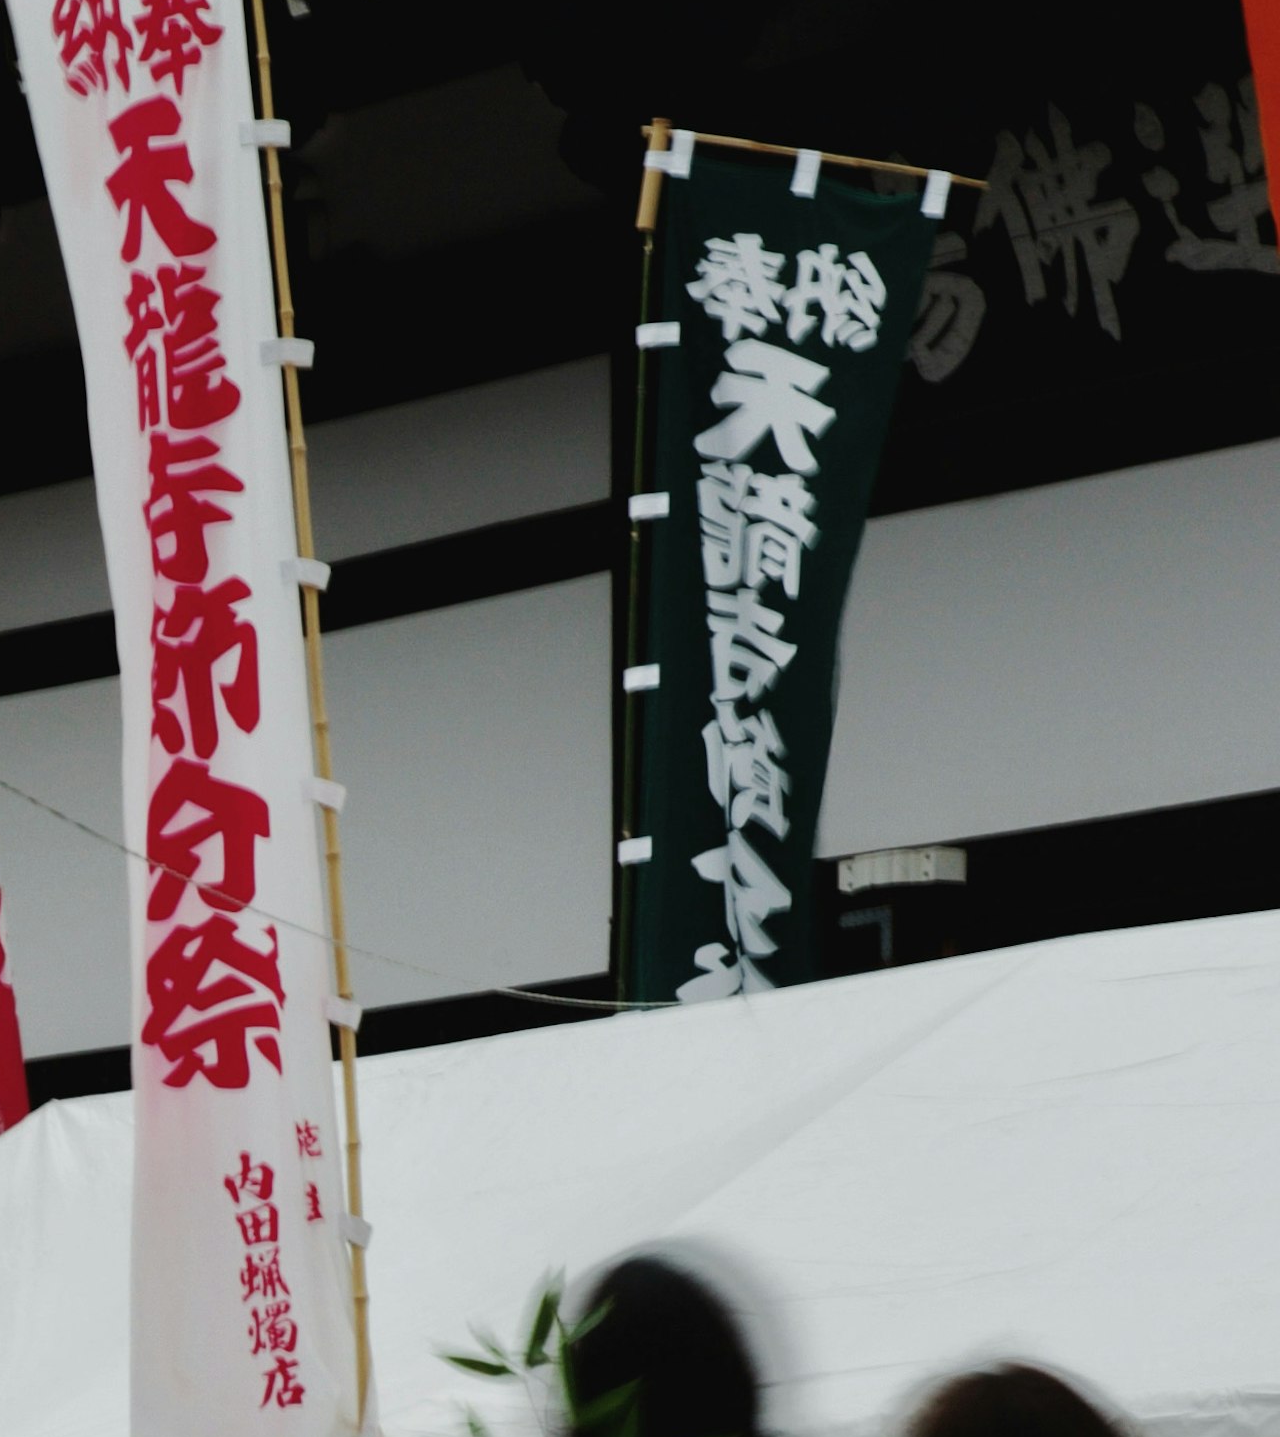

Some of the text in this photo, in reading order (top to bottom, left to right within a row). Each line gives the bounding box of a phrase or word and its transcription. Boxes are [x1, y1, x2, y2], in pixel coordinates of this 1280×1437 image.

[105, 94, 287, 1090] 天龍寺節分祭
